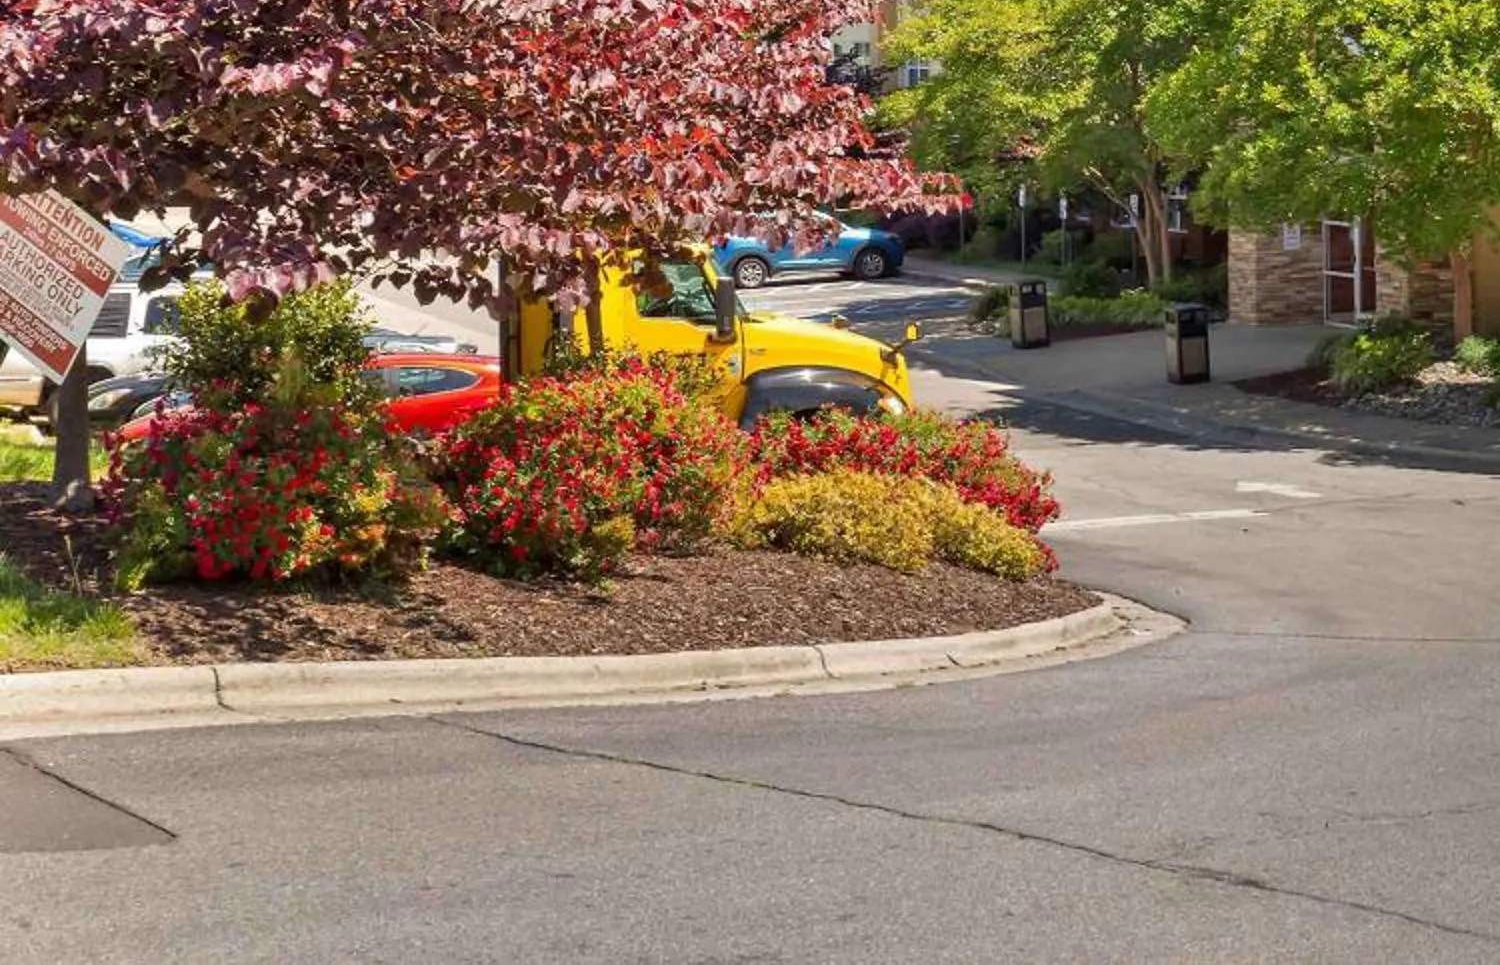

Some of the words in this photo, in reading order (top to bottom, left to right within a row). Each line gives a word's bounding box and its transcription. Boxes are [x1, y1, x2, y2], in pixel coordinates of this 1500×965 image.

[1, 229, 84, 300] AUTHORIZED
[47, 226, 111, 282] ENFORCED
[47, 284, 84, 316] ONLY
